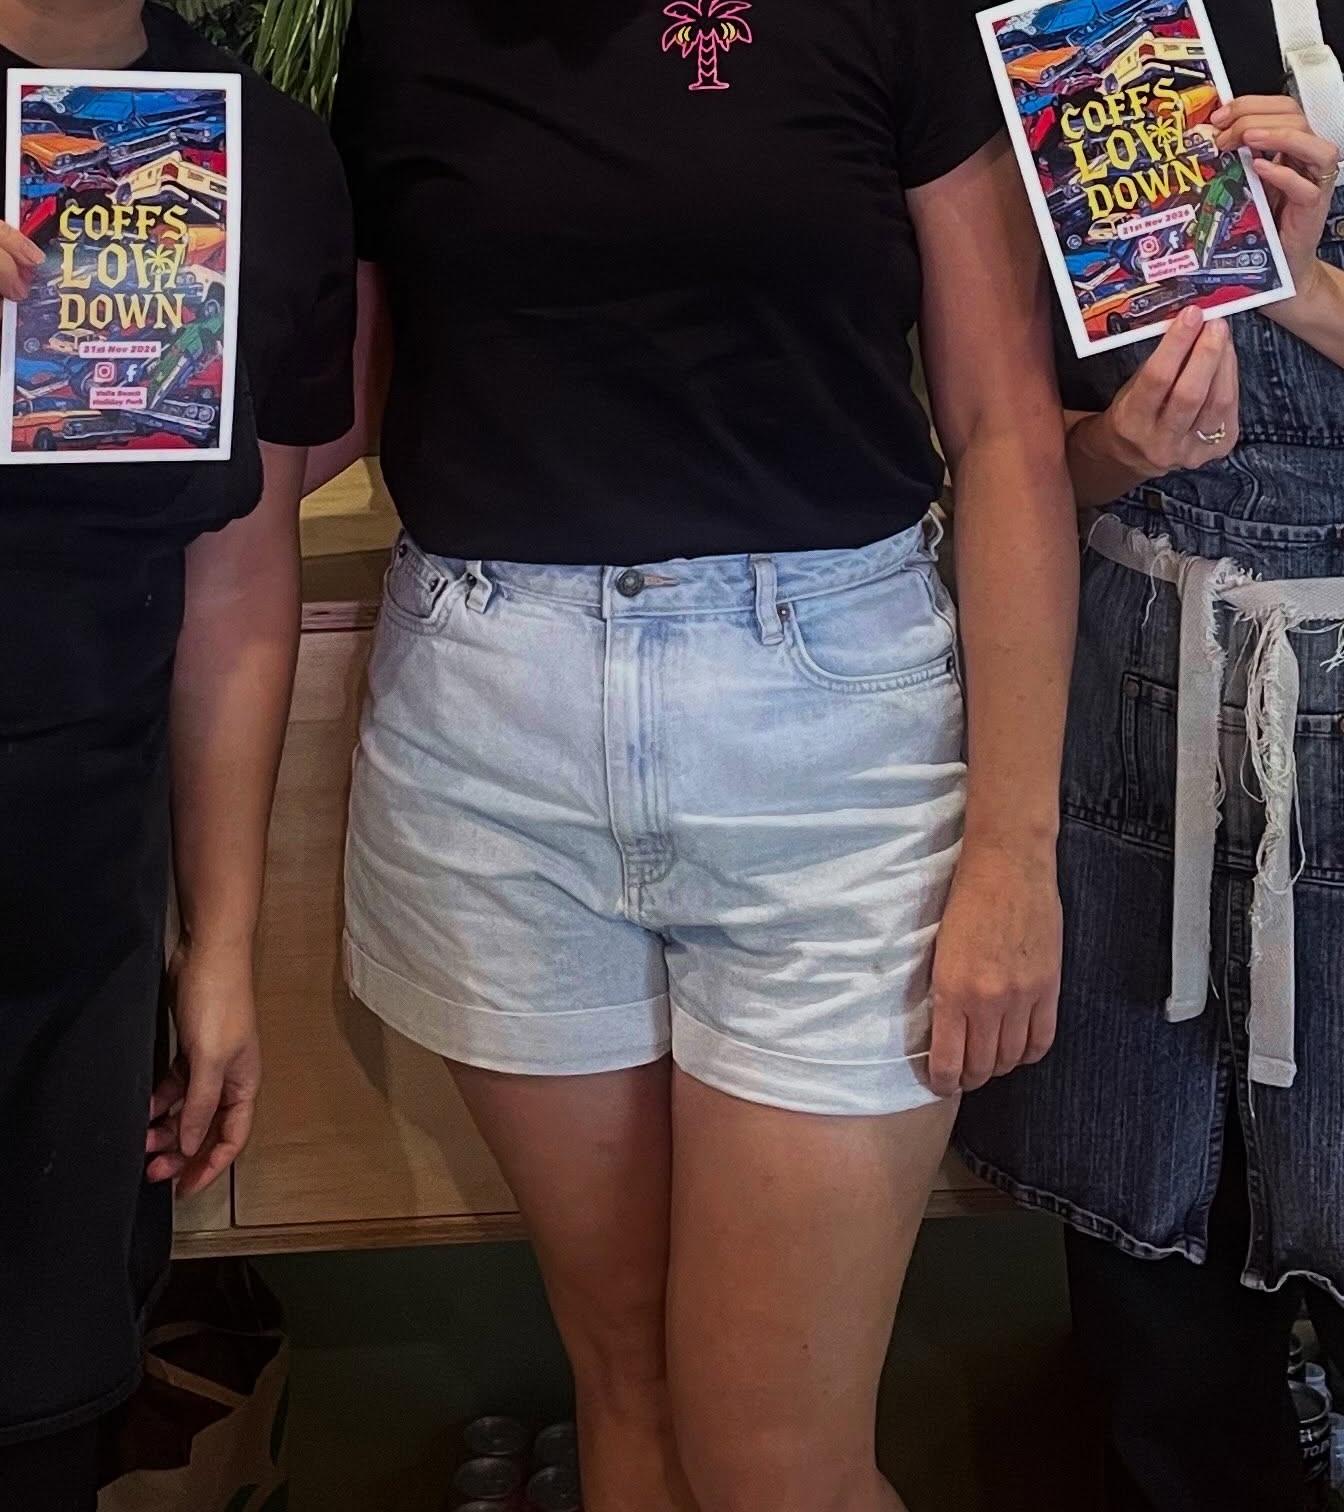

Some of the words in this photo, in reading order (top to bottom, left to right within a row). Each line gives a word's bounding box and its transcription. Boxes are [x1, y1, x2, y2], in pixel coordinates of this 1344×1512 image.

[1061, 77, 1179, 139] COFFS
[1070, 105, 1186, 182] LOW
[1087, 156, 1206, 222] DOWN
[60, 204, 188, 241] COFFS
[1145, 219, 1163, 228] Nov
[60, 243, 186, 291] LOW
[58, 293, 184, 330] DOWN
